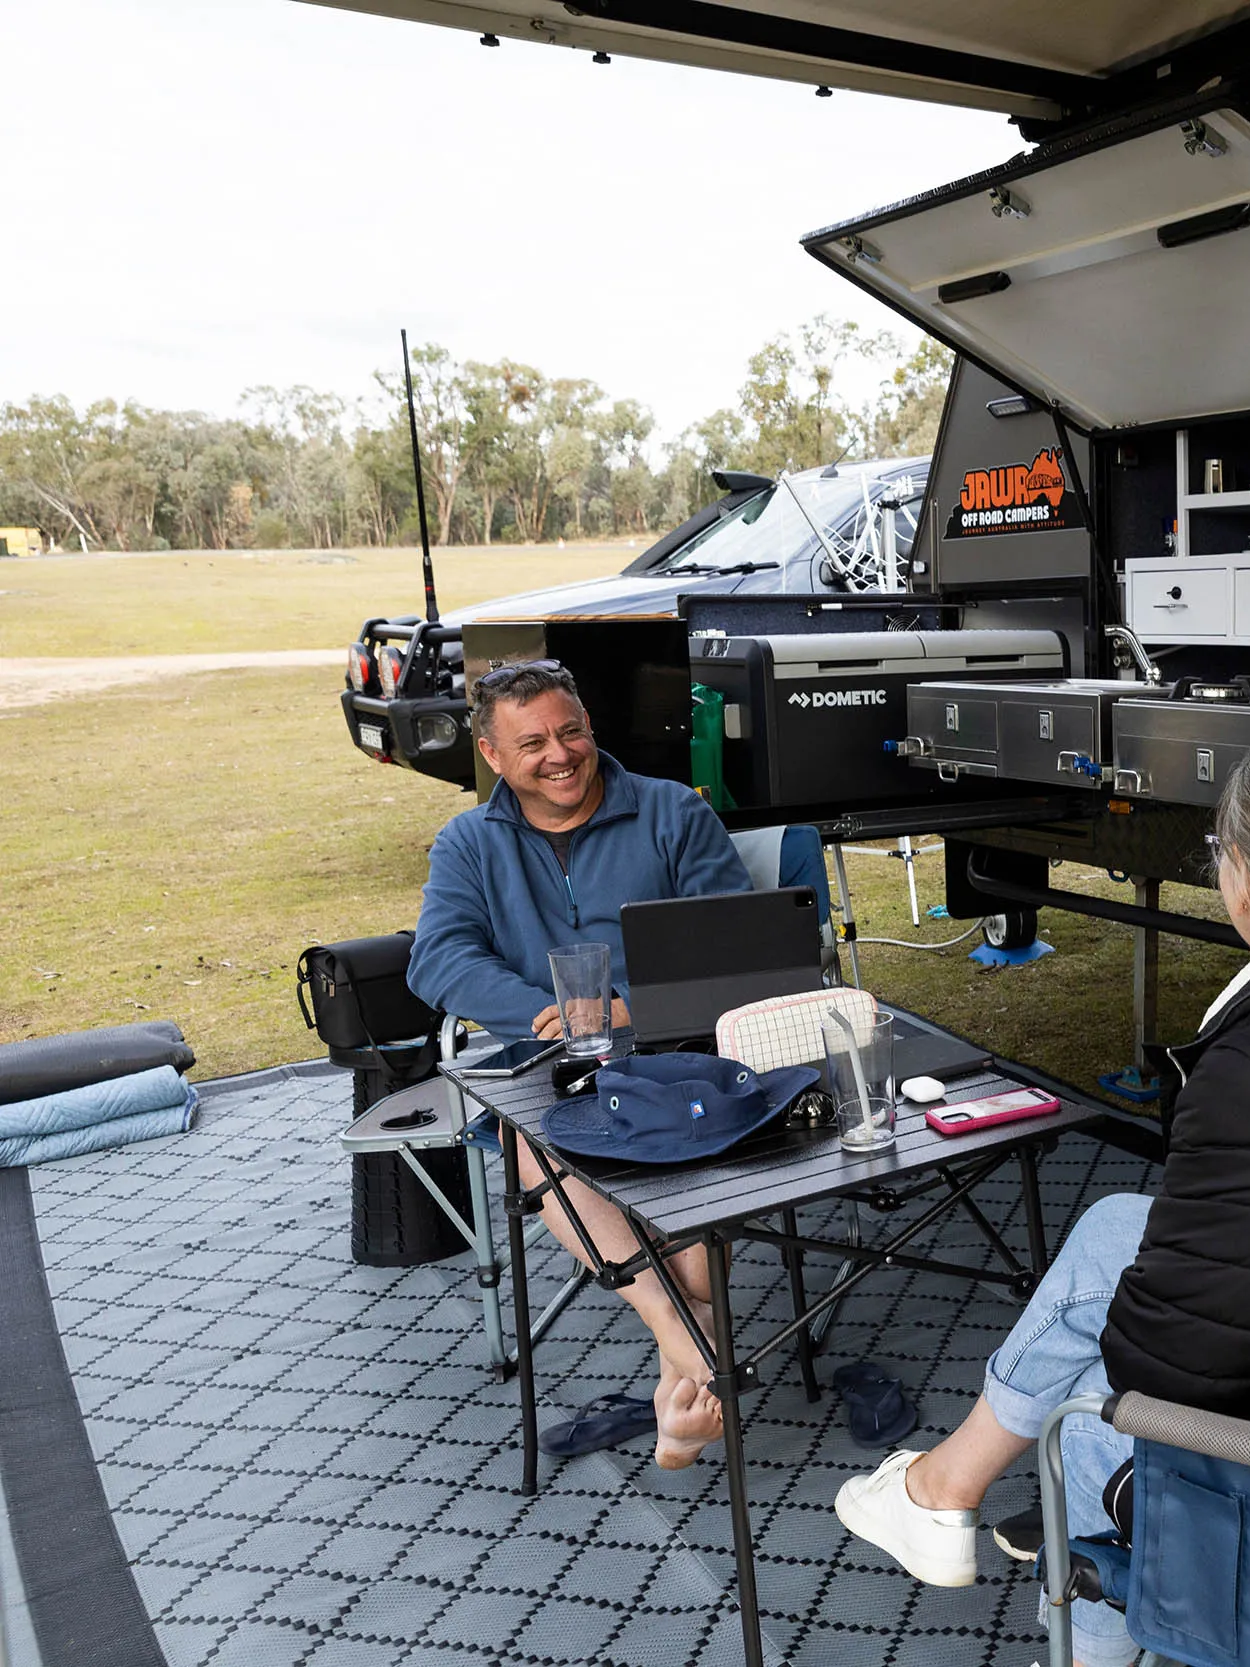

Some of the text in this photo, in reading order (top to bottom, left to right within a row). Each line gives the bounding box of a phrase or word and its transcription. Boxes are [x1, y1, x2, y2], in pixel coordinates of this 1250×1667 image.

[961, 466, 1030, 510] JAWA
[961, 505, 1049, 527] OFF ROAD CAMPERS
[812, 689, 887, 707] DOMETIC
